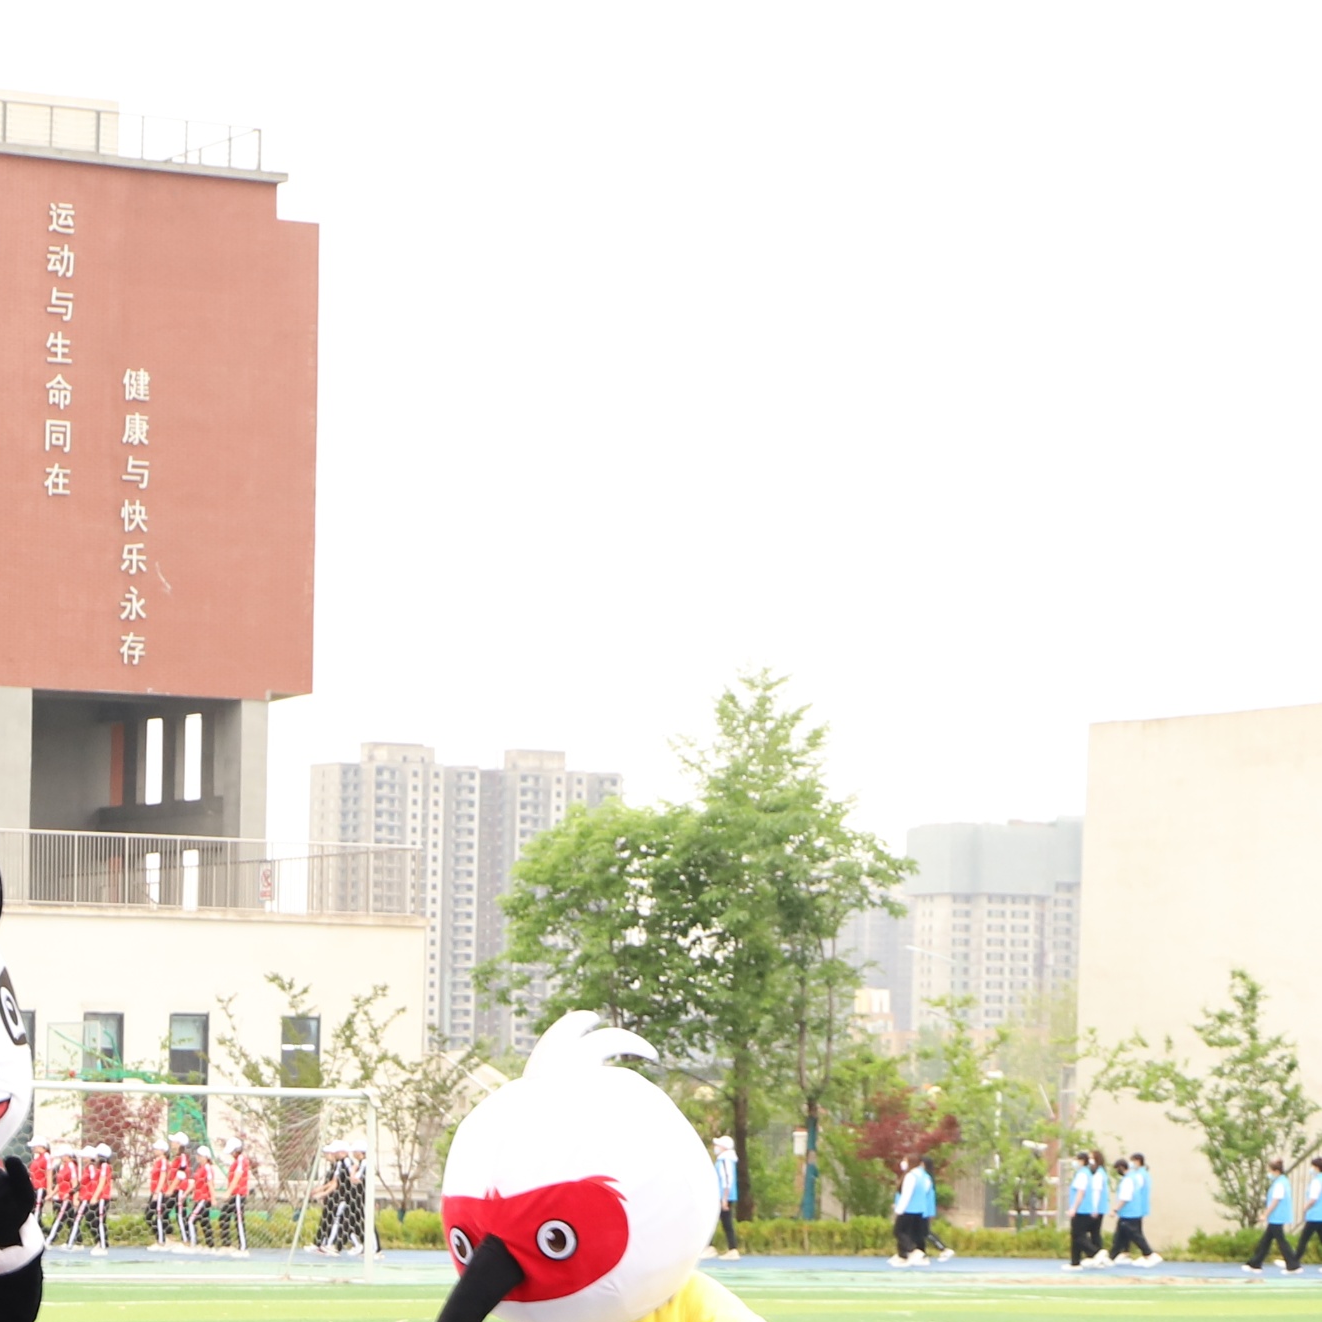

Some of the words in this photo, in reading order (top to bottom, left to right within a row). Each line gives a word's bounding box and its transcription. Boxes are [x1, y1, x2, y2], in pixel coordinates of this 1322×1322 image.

[44, 202, 75, 496] 运动与生命同在
[119, 368, 150, 665] 健康与快乐永存
